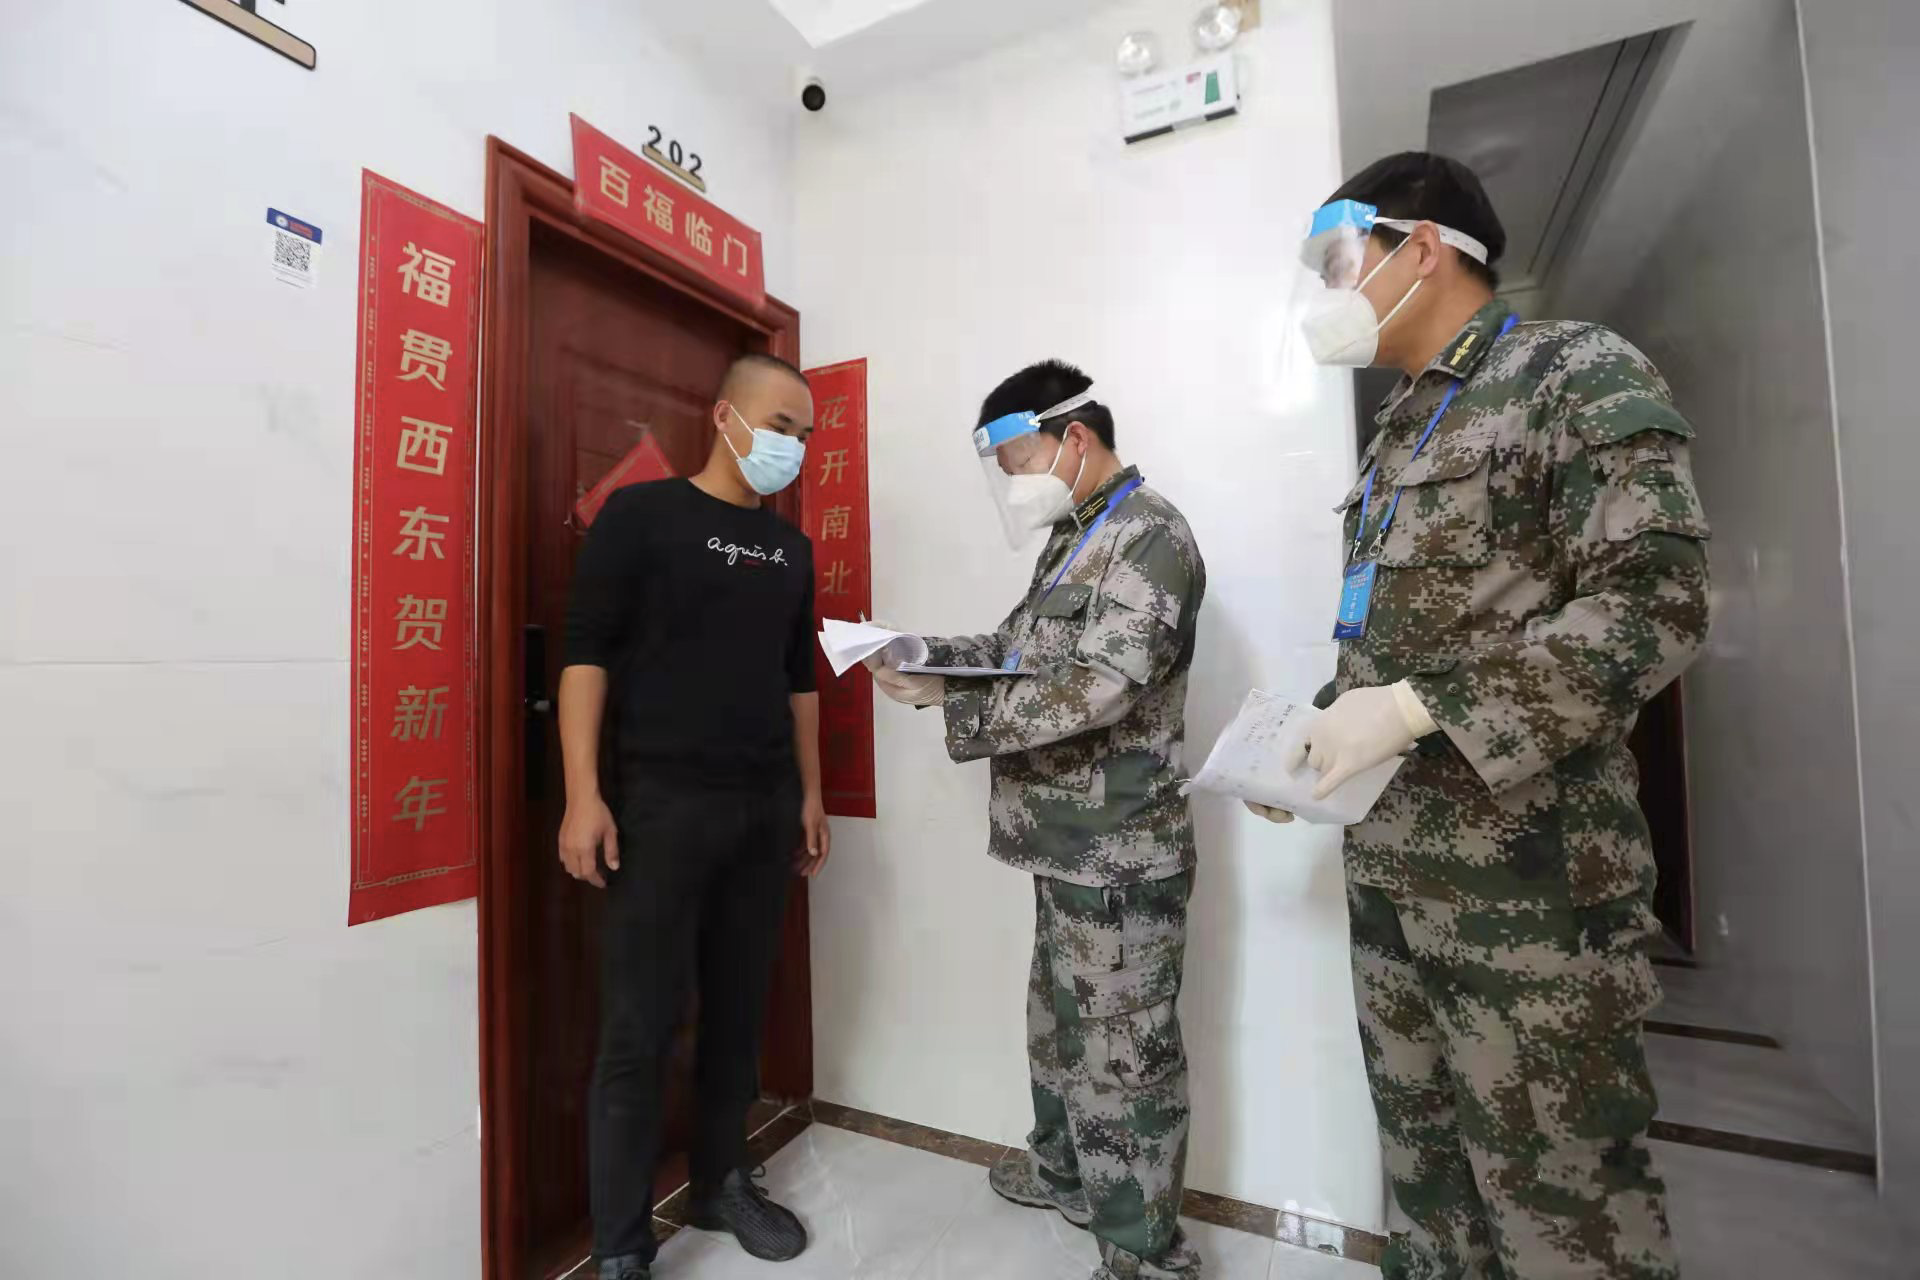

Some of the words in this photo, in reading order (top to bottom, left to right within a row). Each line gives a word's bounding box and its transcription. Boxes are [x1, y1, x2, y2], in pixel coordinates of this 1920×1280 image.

[647, 125, 702, 181] 202
[598, 155, 748, 277] 百福临门
[390, 241, 456, 832] 福贯西东贺新年
